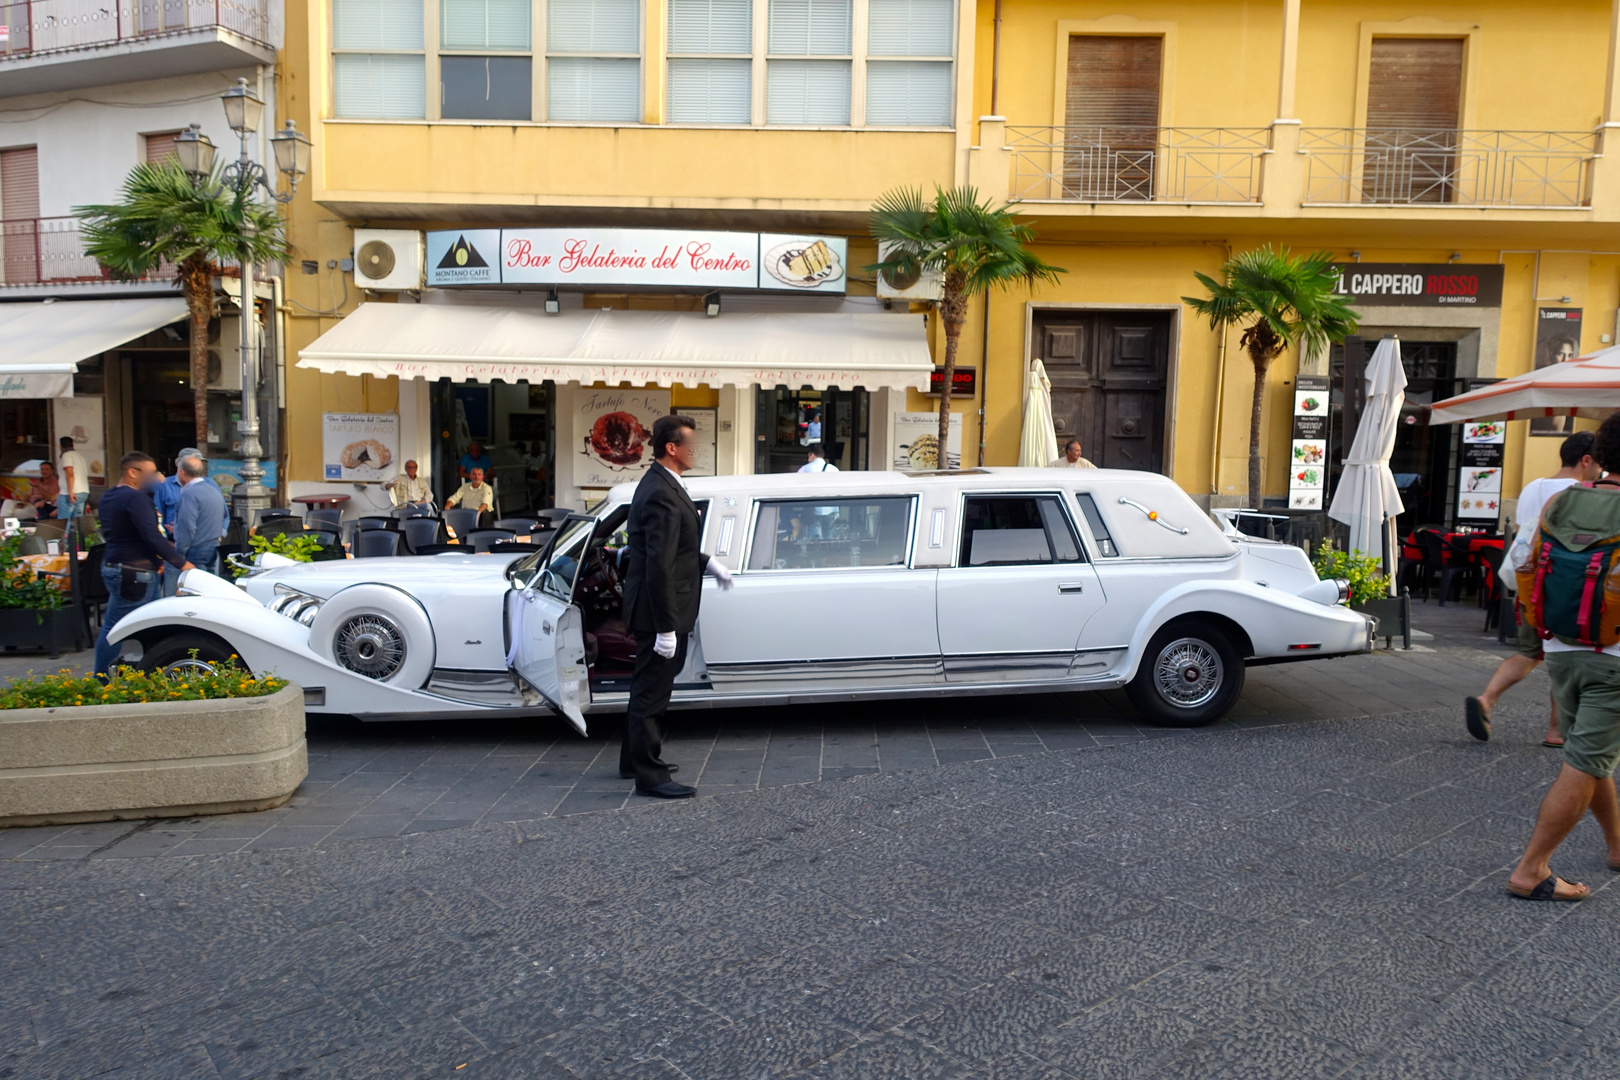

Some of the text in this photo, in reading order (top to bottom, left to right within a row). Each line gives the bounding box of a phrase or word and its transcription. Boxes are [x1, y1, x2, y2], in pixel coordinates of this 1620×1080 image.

[507, 238, 752, 273] Bar Gelateria del Centro
[1351, 274, 1423, 294] CAPPERO
[1426, 275, 1478, 295] ROSSO
[395, 363, 861, 381] Bar Gelateria Artigianale del Centro
[931, 373, 972, 382] KIBO
[581, 393, 663, 416] Tartufo Nero
[328, 424, 361, 433] TARTUFO
[587, 474, 607, 484] Bar
[611, 475, 626, 484] del
